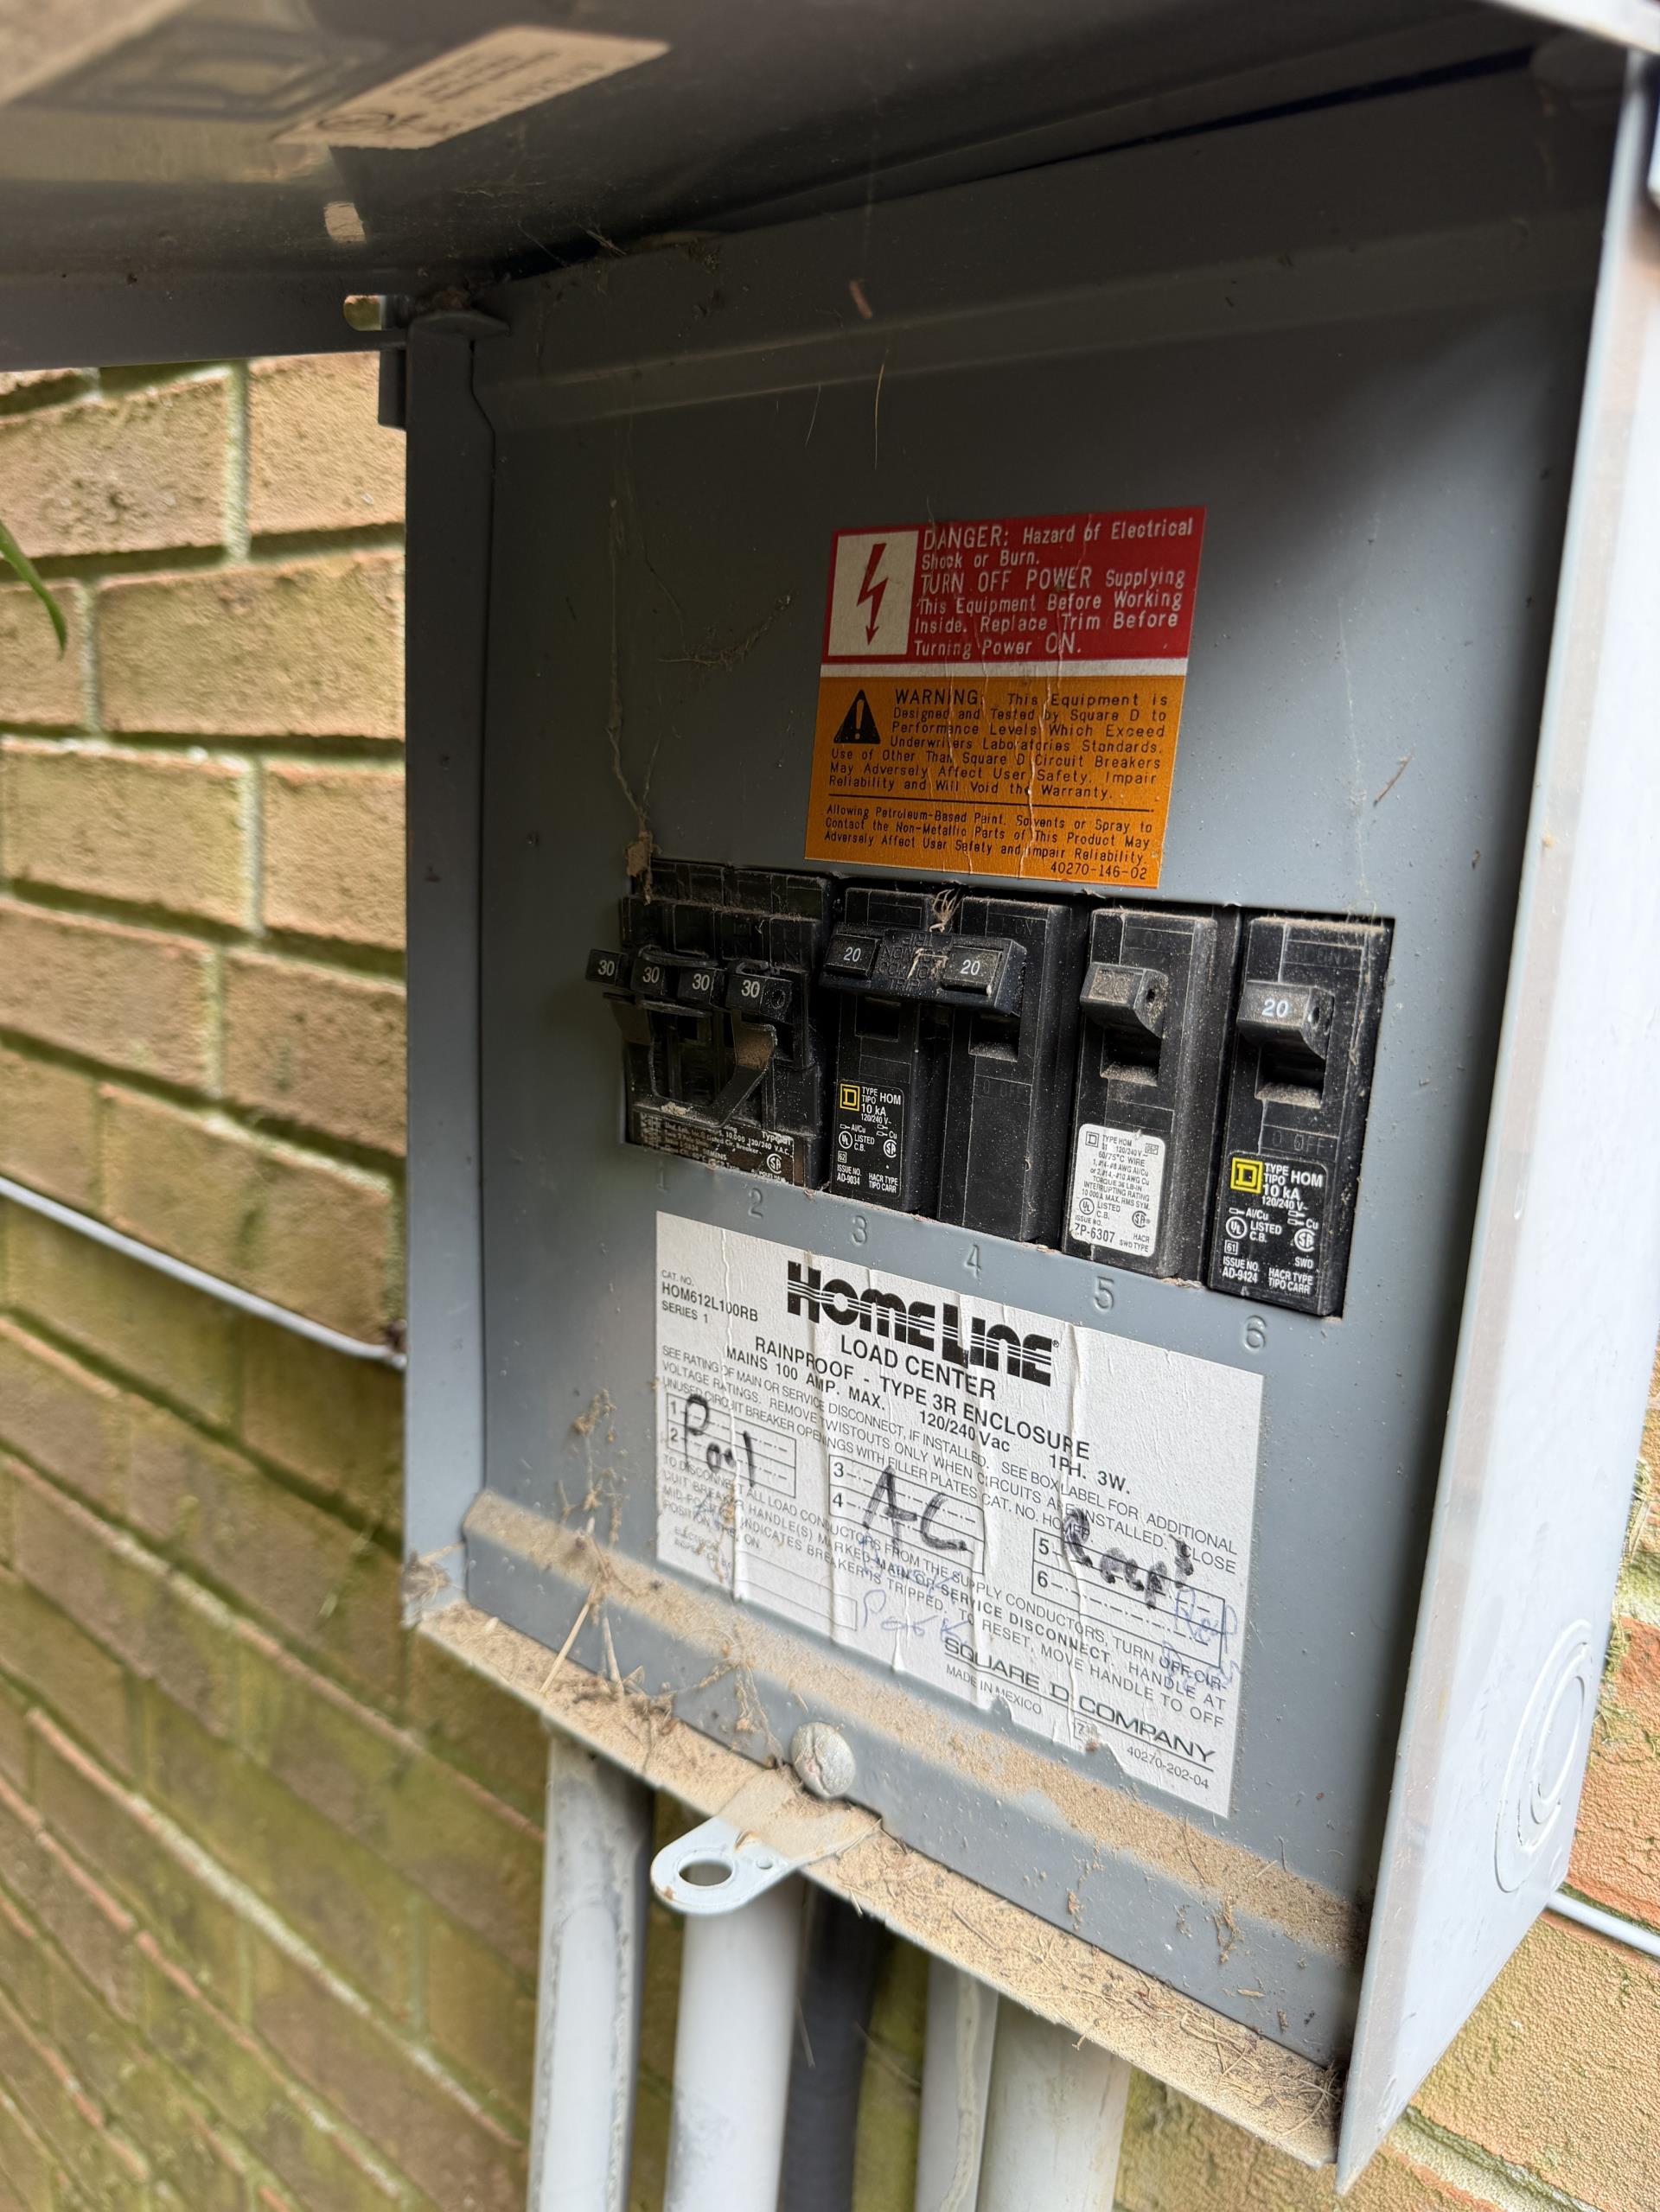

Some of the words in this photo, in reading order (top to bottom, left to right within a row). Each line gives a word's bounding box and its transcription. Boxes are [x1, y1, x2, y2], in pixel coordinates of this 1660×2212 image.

[923, 524, 1010, 551] DANGER:
[1023, 524, 1076, 544] Hazard
[1083, 522, 1101, 540] of
[1110, 517, 1194, 539] Electrical
[974, 554, 989, 567] or
[999, 548, 1041, 566] Burn.
[919, 573, 964, 596] TURN
[977, 571, 1011, 591] OFF
[1025, 567, 1091, 590] POWER
[1104, 566, 1185, 590] Supplying
[917, 598, 947, 615] This
[955, 595, 1037, 616] Equipment
[1047, 592, 1102, 610] Before
[1112, 589, 1183, 612] Working
[914, 616, 968, 634] Inside.
[980, 615, 1047, 634] Replace
[1060, 613, 1101, 630] Trim
[1113, 609, 1178, 628] Before
[913, 639, 972, 660] Turning
[981, 638, 1032, 654] Power
[1044, 631, 1083, 654] ON.
[1006, 693, 1038, 705] This
[1050, 693, 1140, 709] Equipment
[1152, 694, 1168, 706] is
[893, 707, 950, 721] Designed
[957, 708, 980, 719] and
[990, 708, 1035, 720] Tested
[1069, 709, 1120, 724] Square
[1151, 711, 1166, 722] to
[892, 722, 979, 735] Performance
[989, 724, 1037, 736] Levels
[1047, 724, 1093, 736] Which
[1106, 725, 1165, 737] Exceed
[831, 749, 852, 760] Use
[861, 749, 872, 760] of
[882, 749, 914, 762] Other
[926, 751, 951, 762] Than
[962, 752, 1007, 767] Square
[1034, 754, 1083, 767] Circuit
[1094, 755, 1160, 769] Breakers
[830, 762, 853, 776] May
[863, 763, 928, 778] Adversely
[938, 766, 983, 779] Affect
[993, 768, 1026, 781] User
[1105, 773, 1157, 787] Impair
[828, 775, 894, 790] Reliability
[903, 778, 926, 790] and
[935, 780, 959, 792] Will
[969, 781, 999, 794] Void
[1040, 785, 1114, 801] Warranty.
[1095, 819, 1130, 834] Spray
[1140, 823, 1152, 833] to
[974, 826, 1005, 839] Parts
[1013, 829, 1025, 840] of
[1066, 832, 1114, 847] Product
[1124, 837, 1150, 851] May
[1050, 861, 1147, 881] 40270-146-02
[843, 948, 861, 963] 20
[598, 959, 616, 977] 30
[643, 966, 660, 984] 30
[961, 960, 980, 976] 20
[693, 973, 710, 991] 30
[742, 979, 760, 998] 30
[1262, 1000, 1289, 1017] 20
[879, 1093, 901, 1105] HOM
[861, 1104, 872, 1113] 10
[875, 1106, 886, 1116] kA
[854, 1134, 874, 1144] LISTED
[1127, 1155, 1145, 1167] WIRE
[869, 1173, 883, 1182] HACR
[1264, 1163, 1288, 1176] TYPE
[1291, 1170, 1323, 1188] HOM
[1264, 1174, 1286, 1185] TIPO
[1263, 1183, 1280, 1196] 10
[1283, 1187, 1300, 1201] kA
[1097, 1202, 1120, 1212] LISTED
[1261, 1196, 1294, 1209] 120/240
[1250, 1222, 1282, 1235] LISTED
[1306, 1219, 1318, 1229] Cu
[1133, 1234, 1149, 1243] HACR
[964, 1244, 981, 1278] 4
[1223, 1256, 1246, 1268] ISSUE
[1294, 1257, 1313, 1269] SWD
[1268, 1278, 1286, 1291] TIPO
[1269, 1268, 1291, 1280] HACR
[1293, 1272, 1314, 1285] TYPE
[661, 1281, 758, 1323] HOM612L100RB
[1094, 1276, 1114, 1312] 5
[661, 1299, 697, 1320] SERIES
[1243, 1314, 1267, 1351] 6
[840, 1334, 897, 1369] LOAD
[905, 1354, 995, 1401] CENTER
[670, 1399, 676, 1414] 1
[756, 1335, 853, 1384] RAINPROOF
[879, 1375, 926, 1406] TYPE
[932, 1393, 956, 1416] 3R
[963, 1402, 1089, 1460] ENCLOSURE
[662, 1360, 708, 1386] VOLTAGE
[769, 1397, 817, 1424] REMOVE
[894, 1441, 928, 1463] ONLY
[933, 1456, 972, 1480] WHEN
[726, 1345, 767, 1371] MAINS
[776, 1361, 797, 1380] 100
[806, 1371, 840, 1396] AMP.
[848, 1386, 884, 1411] MAX.
[920, 1409, 975, 1441] 120/240
[979, 1430, 1010, 1453] Vac
[1049, 1452, 1087, 1480] 1PH.
[1097, 1469, 1131, 1495] 3W.
[670, 1427, 677, 1442] 2
[662, 1344, 683, 1361] SEE
[683, 1352, 718, 1374] RATING
[737, 1370, 761, 1388] MAIN
[764, 1380, 779, 1394] OR
[782, 1385, 824, 1412] SERVICE
[828, 1401, 905, 1440] DISCONNECT,
[910, 1429, 919, 1443] IF
[923, 1433, 989, 1469] INSTALLED.
[1001, 1460, 1027, 1481] SEE
[1031, 1471, 1058, 1492] BOX
[1061, 1482, 1105, 1508] LABEL
[1108, 1498, 1138, 1520] FOR
[1146, 1512, 1237, 1555] ADDITIONAL
[745, 1405, 794, 1432] BREAKER
[856, 1445, 884, 1465] WITH
[930, 1472, 976, 1499] PLATES
[1016, 1502, 1038, 1522] NO.
[833, 1460, 844, 1478] 3
[833, 1490, 843, 1508] 4
[865, 1464, 967, 1555] AC
[1038, 1537, 1049, 1556] 5
[747, 1487, 765, 1504] ALL
[768, 1495, 796, 1516] LOAD
[884, 1542, 919, 1567] FROM
[923, 1558, 948, 1578] THE
[1006, 1591, 1108, 1647] CONDUCTORS,
[1113, 1635, 1153, 1663] TURN
[1037, 1570, 1048, 1589] 6
[750, 1504, 812, 1541] HANDLE(S)
[1009, 1612, 1114, 1666] DISCONNECT.
[1128, 1661, 1196, 1699] HANDLE
[1203, 1692, 1225, 1712] AT
[741, 1516, 801, 1551] INDICATES
[886, 1577, 947, 1613] TRIPPED.
[982, 1617, 1033, 1652] RESET,
[1040, 1642, 1088, 1673] MOVE
[1089, 1663, 1153, 1701] HANDLE
[1159, 1692, 1182, 1712] TO
[1190, 1705, 1223, 1731] OFF
[946, 1663, 976, 1687] MADE
[980, 1679, 992, 1693] IN
[996, 1686, 1041, 1715] MEXICO
[944, 1635, 1039, 1691] SQUARE
[1078, 1693, 1216, 1766] COMPANY
[1127, 1744, 1209, 1789] 40270-202-04
